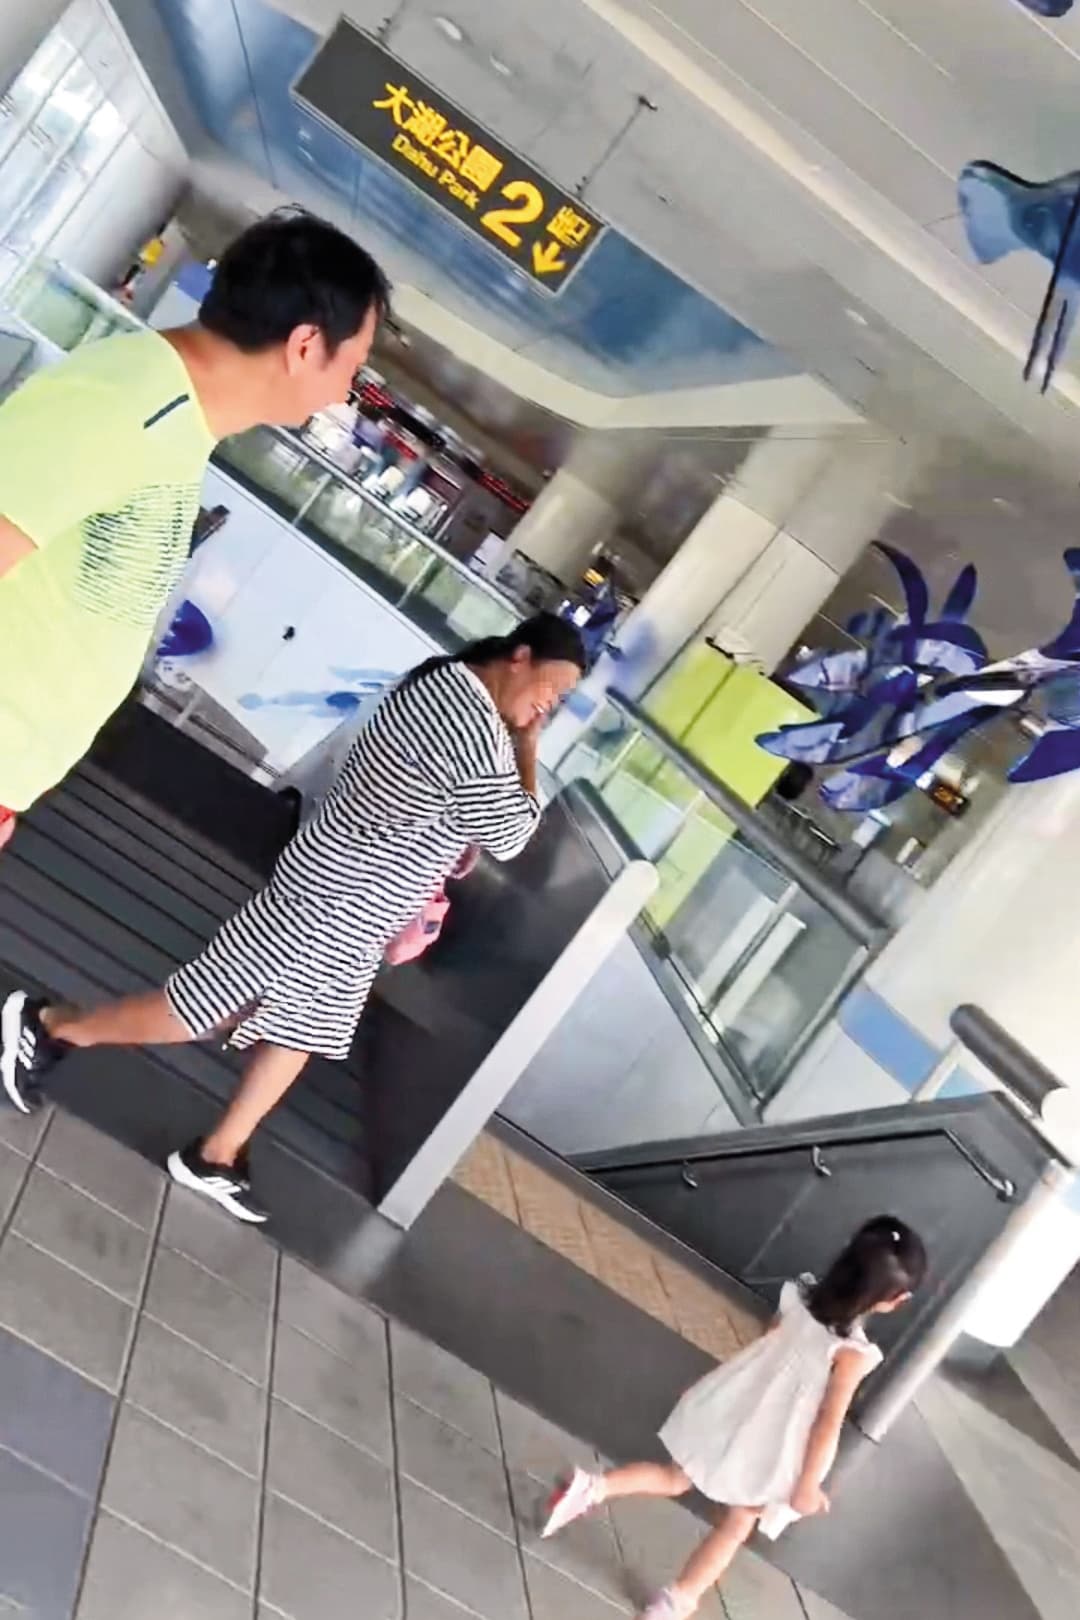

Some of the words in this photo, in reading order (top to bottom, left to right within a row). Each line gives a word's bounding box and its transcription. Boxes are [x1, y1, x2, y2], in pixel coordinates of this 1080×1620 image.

[373, 82, 504, 192] 大湖公園
[392, 133, 438, 178] Dahu
[438, 169, 481, 211] Park
[480, 180, 544, 248] 2
